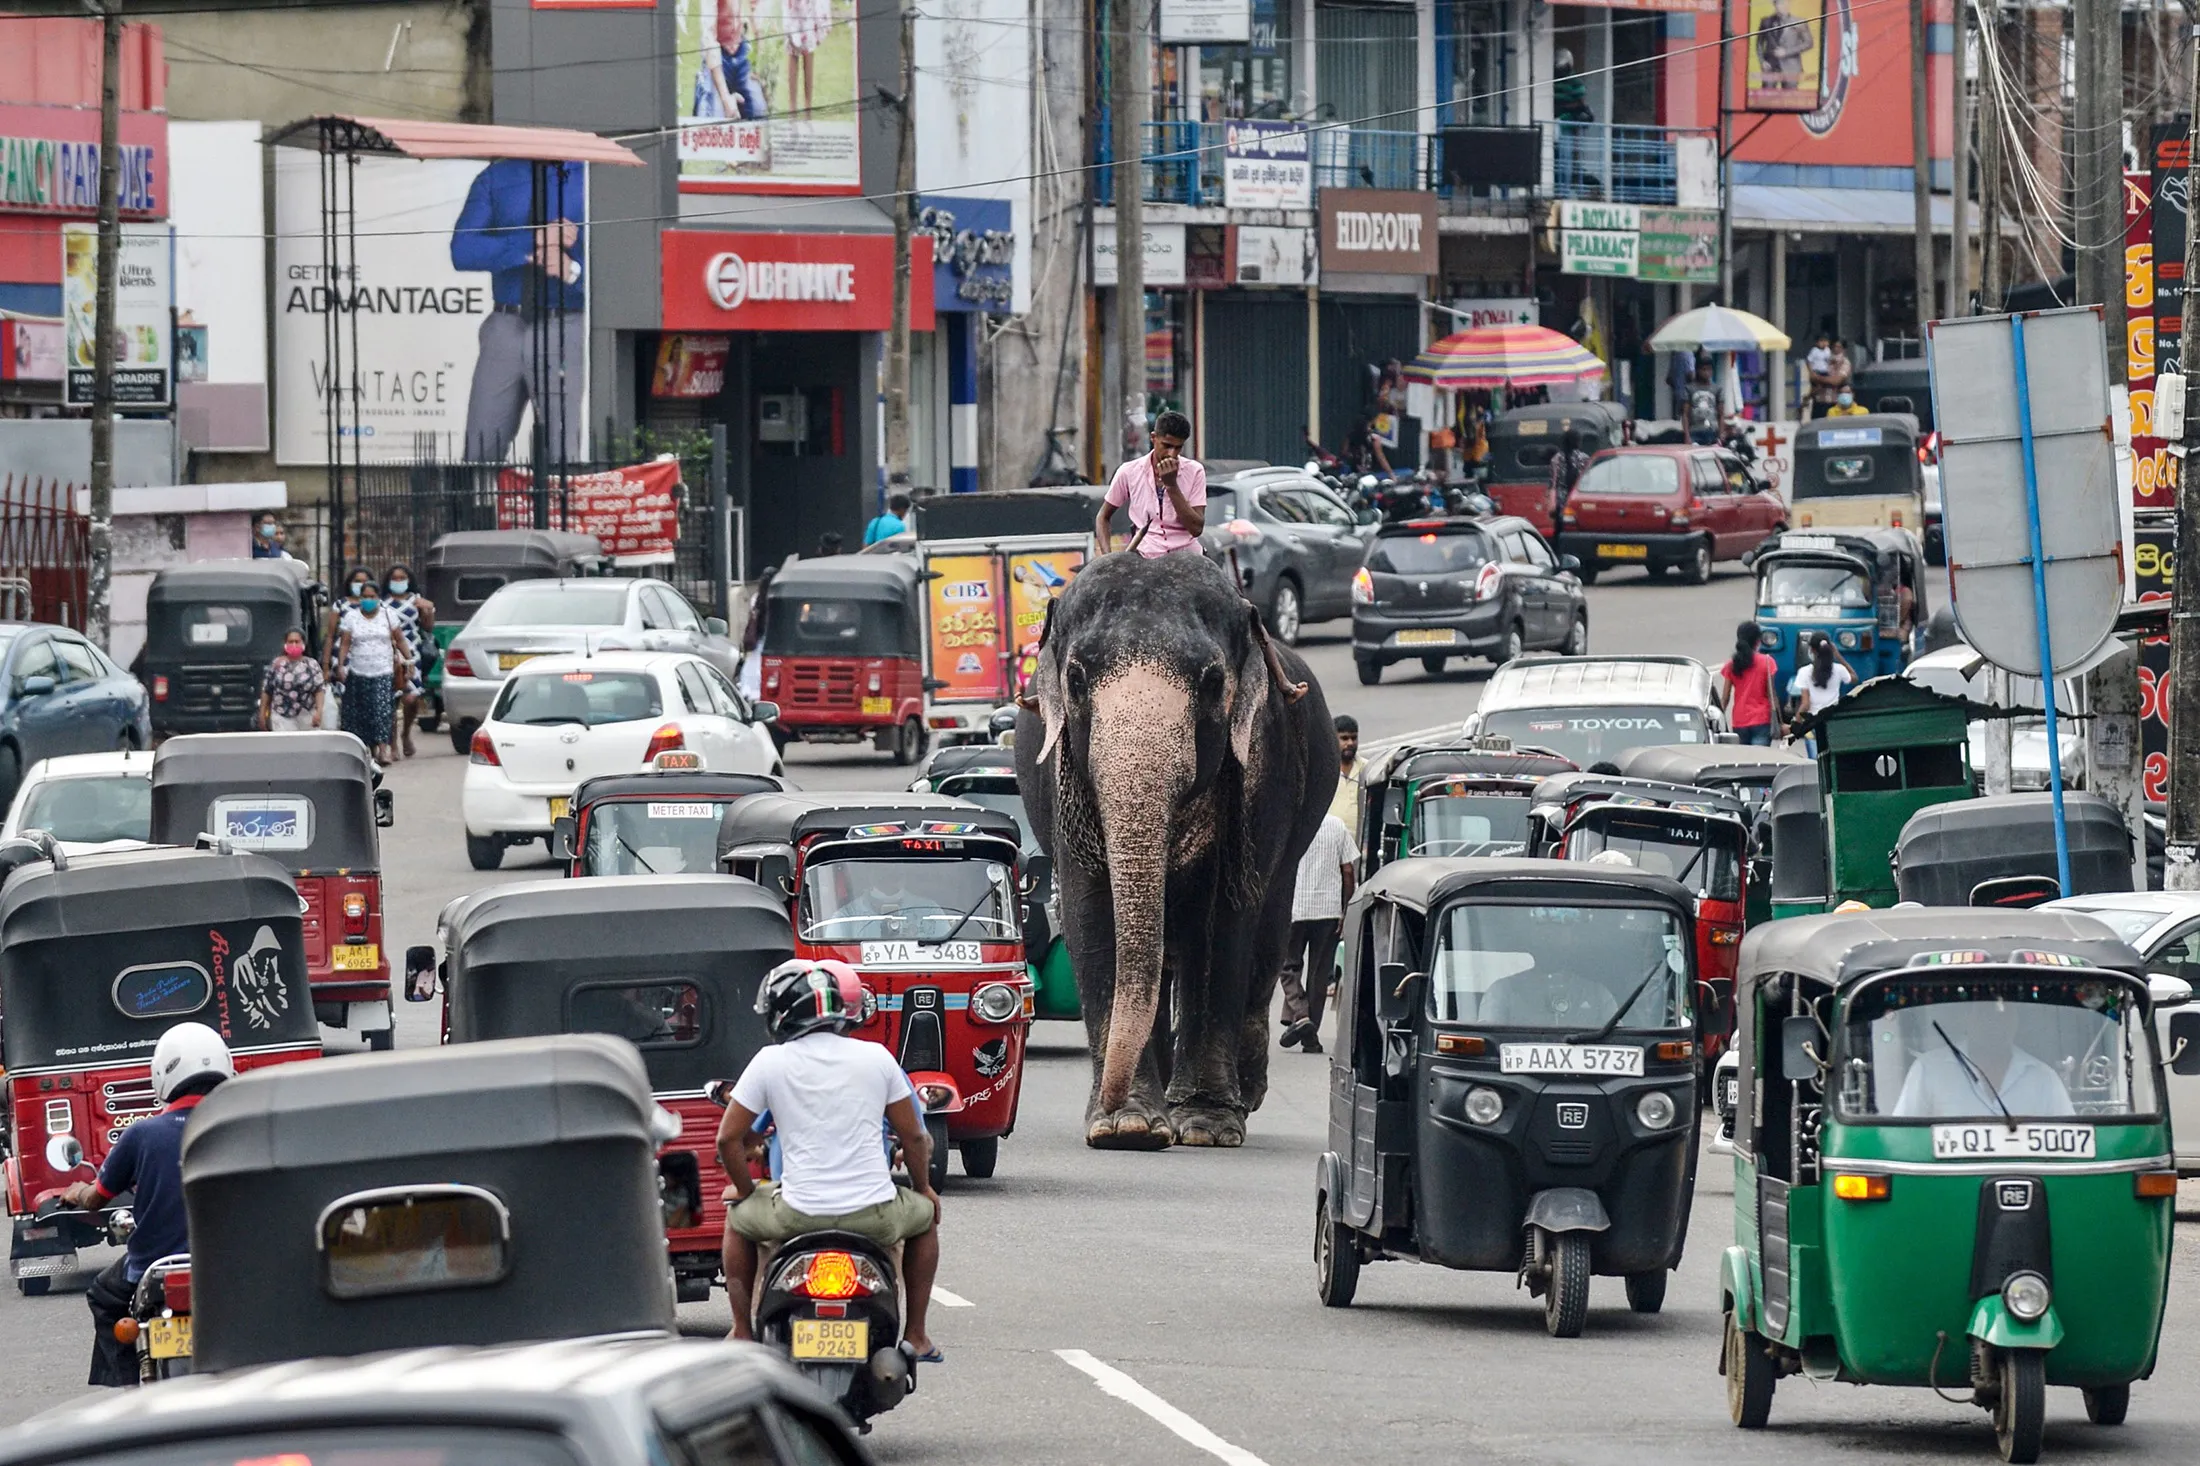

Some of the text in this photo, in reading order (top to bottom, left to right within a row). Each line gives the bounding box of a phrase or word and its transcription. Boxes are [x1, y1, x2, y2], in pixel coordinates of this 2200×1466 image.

[0, 137, 155, 209] ANCY PARDISE
[1582, 208, 1620, 228] ROYAL
[1336, 211, 1422, 252] HIDEOUT
[1567, 234, 1635, 259] PHARMACY
[121, 264, 152, 276] Ultra
[288, 265, 320, 280] GET
[120, 276, 156, 288] Blends
[775, 262, 856, 301] FINANCE
[286, 287, 484, 314] ADVANTAGE
[115, 373, 161, 384] ARADISE
[311, 360, 446, 403] VANTAGE
[943, 584, 980, 598] CIB
[1568, 718, 1663, 730] TOYOTA
[1482, 741, 1509, 751] TAXI
[652, 806, 709, 816] METER TAXI
[902, 839, 941, 851] TAXI
[335, 946, 372, 962] WP AAT
[865, 952, 880, 961] SP
[884, 944, 910, 960] YA
[932, 944, 979, 961] 3483
[347, 957, 372, 968] 6965
[209, 929, 232, 1039] ROCK STYLE
[917, 995, 932, 1005] RE
[1505, 1048, 1640, 1072] WP AAX 5737
[1563, 1111, 1583, 1124] RE
[1937, 1140, 1958, 1153] WP
[1963, 1128, 1995, 1152] QI
[2028, 1128, 2091, 1153] 5007
[2002, 1190, 2026, 1205] RE
[154, 1331, 172, 1345] WP
[819, 1323, 855, 1339] BGO
[797, 1333, 857, 1356] WP 9243
